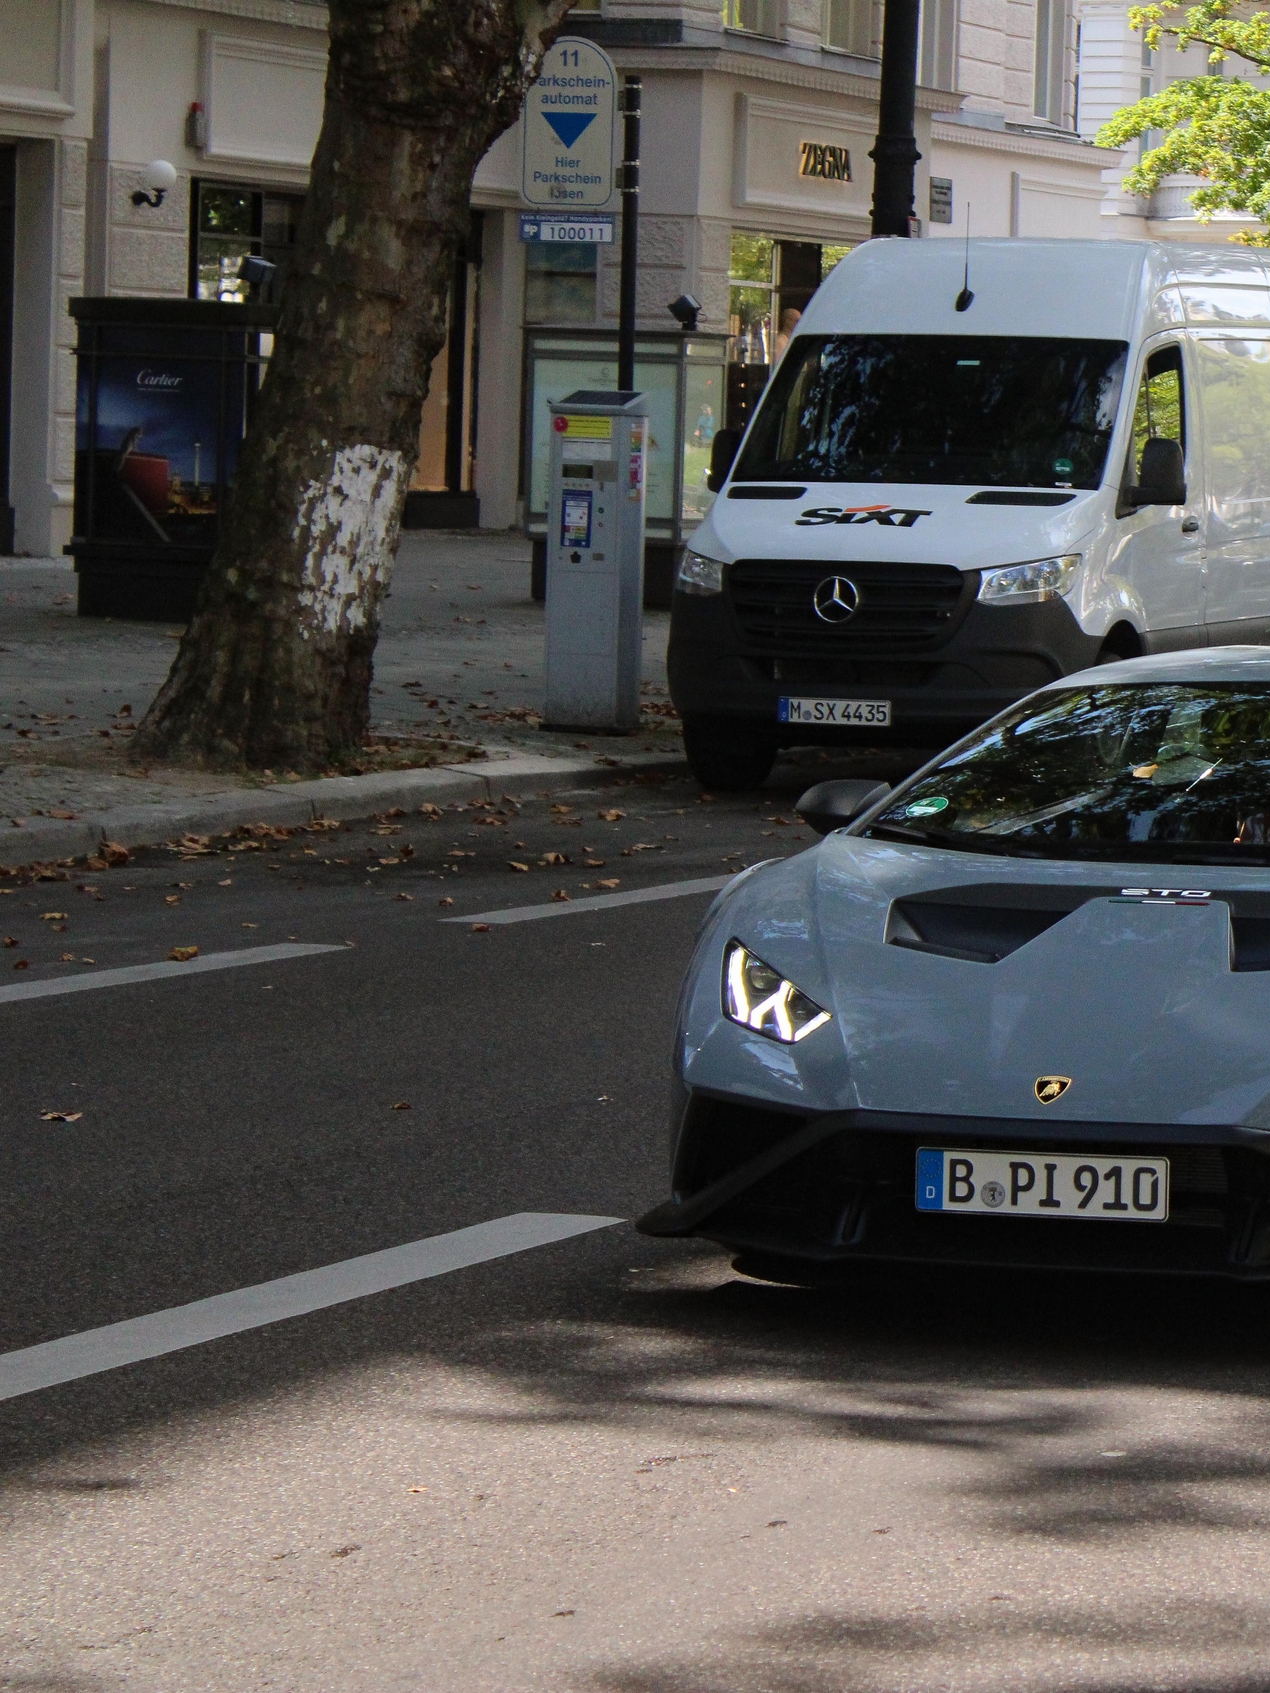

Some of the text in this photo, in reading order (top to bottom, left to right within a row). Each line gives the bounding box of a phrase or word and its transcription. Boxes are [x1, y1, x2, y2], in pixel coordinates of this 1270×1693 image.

[560, 49, 579, 66] 11
[538, 74, 610, 88] arkschein-
[541, 92, 598, 105] automat
[555, 156, 581, 168] Hier
[801, 142, 851, 182] ZEGNA
[533, 171, 602, 184] Parkschein
[550, 227, 604, 240] 100011
[136, 369, 182, 386] Cartier
[790, 701, 801, 719] M
[841, 703, 887, 723] 4435
[1121, 888, 1212, 898] STO
[926, 1186, 936, 1199] D
[949, 1158, 976, 1204] B
